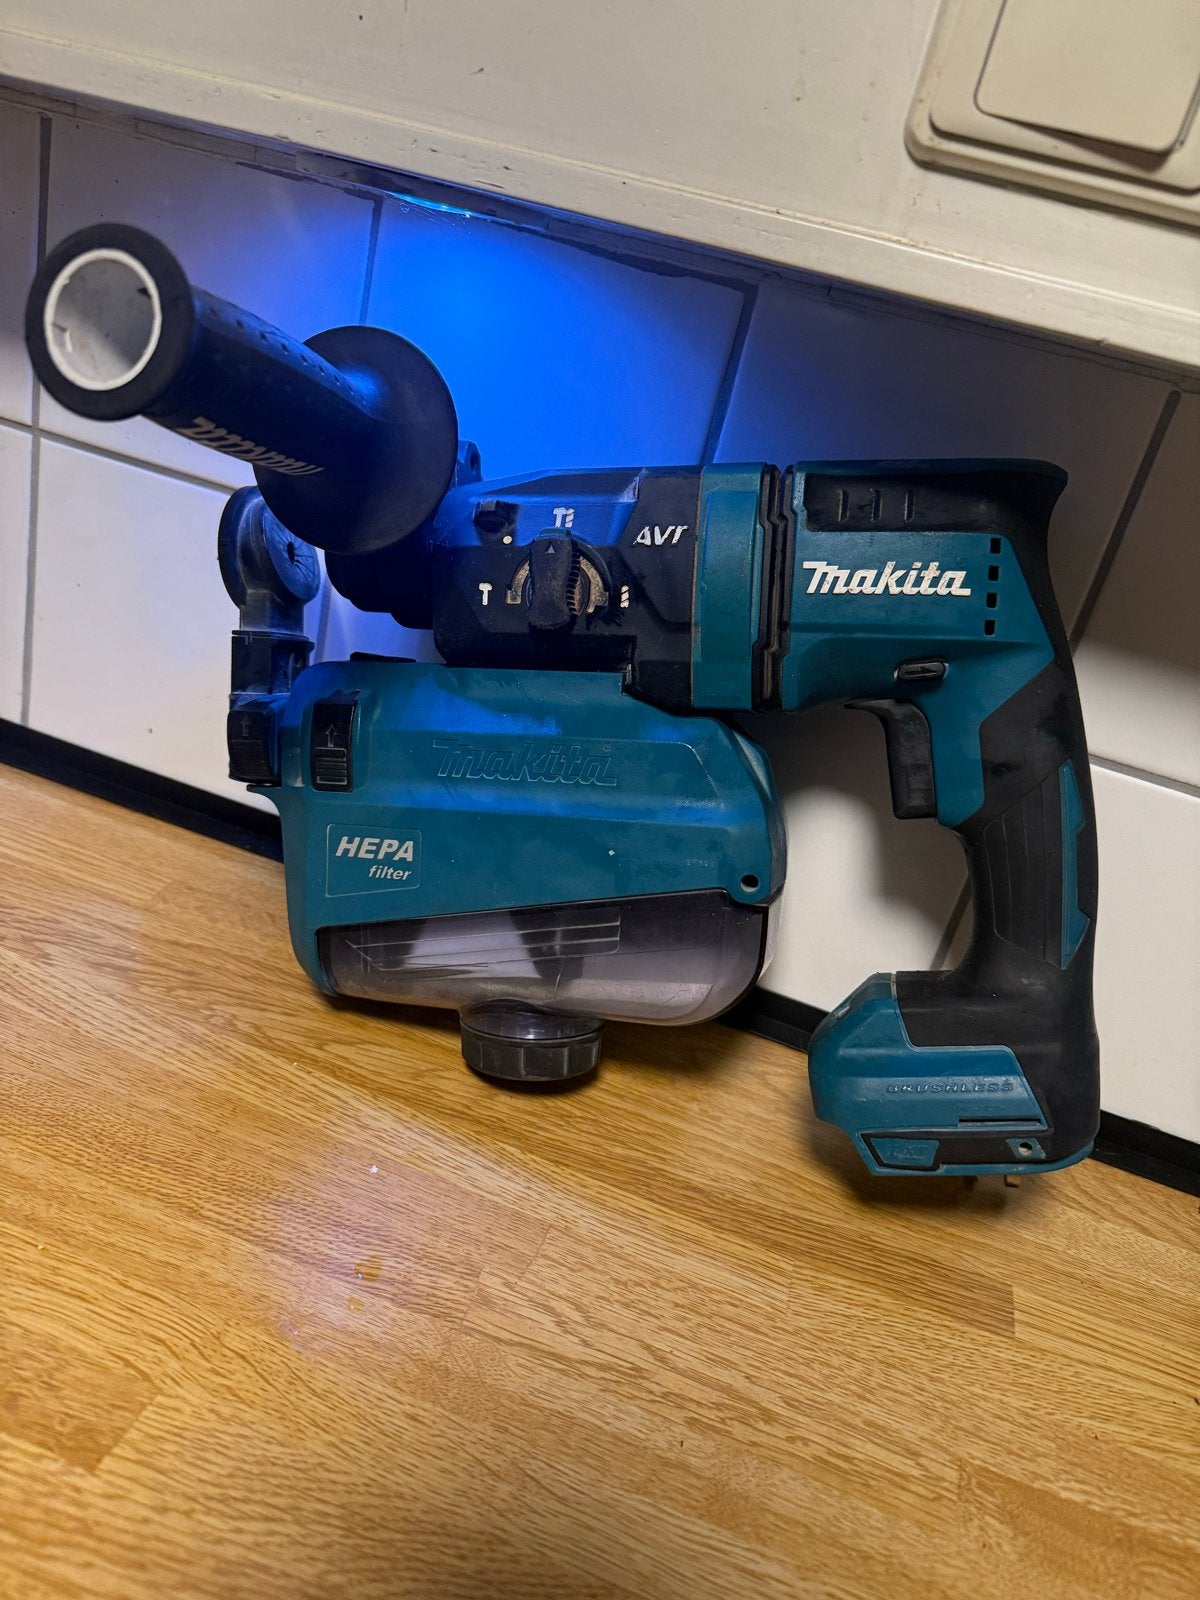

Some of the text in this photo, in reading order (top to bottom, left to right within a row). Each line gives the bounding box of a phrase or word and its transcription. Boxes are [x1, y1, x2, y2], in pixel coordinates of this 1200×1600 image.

[634, 525, 688, 546] AVT
[335, 836, 414, 862] HEPA
[368, 865, 412, 881] filter
[887, 1082, 1014, 1094] BRUSHLESS
